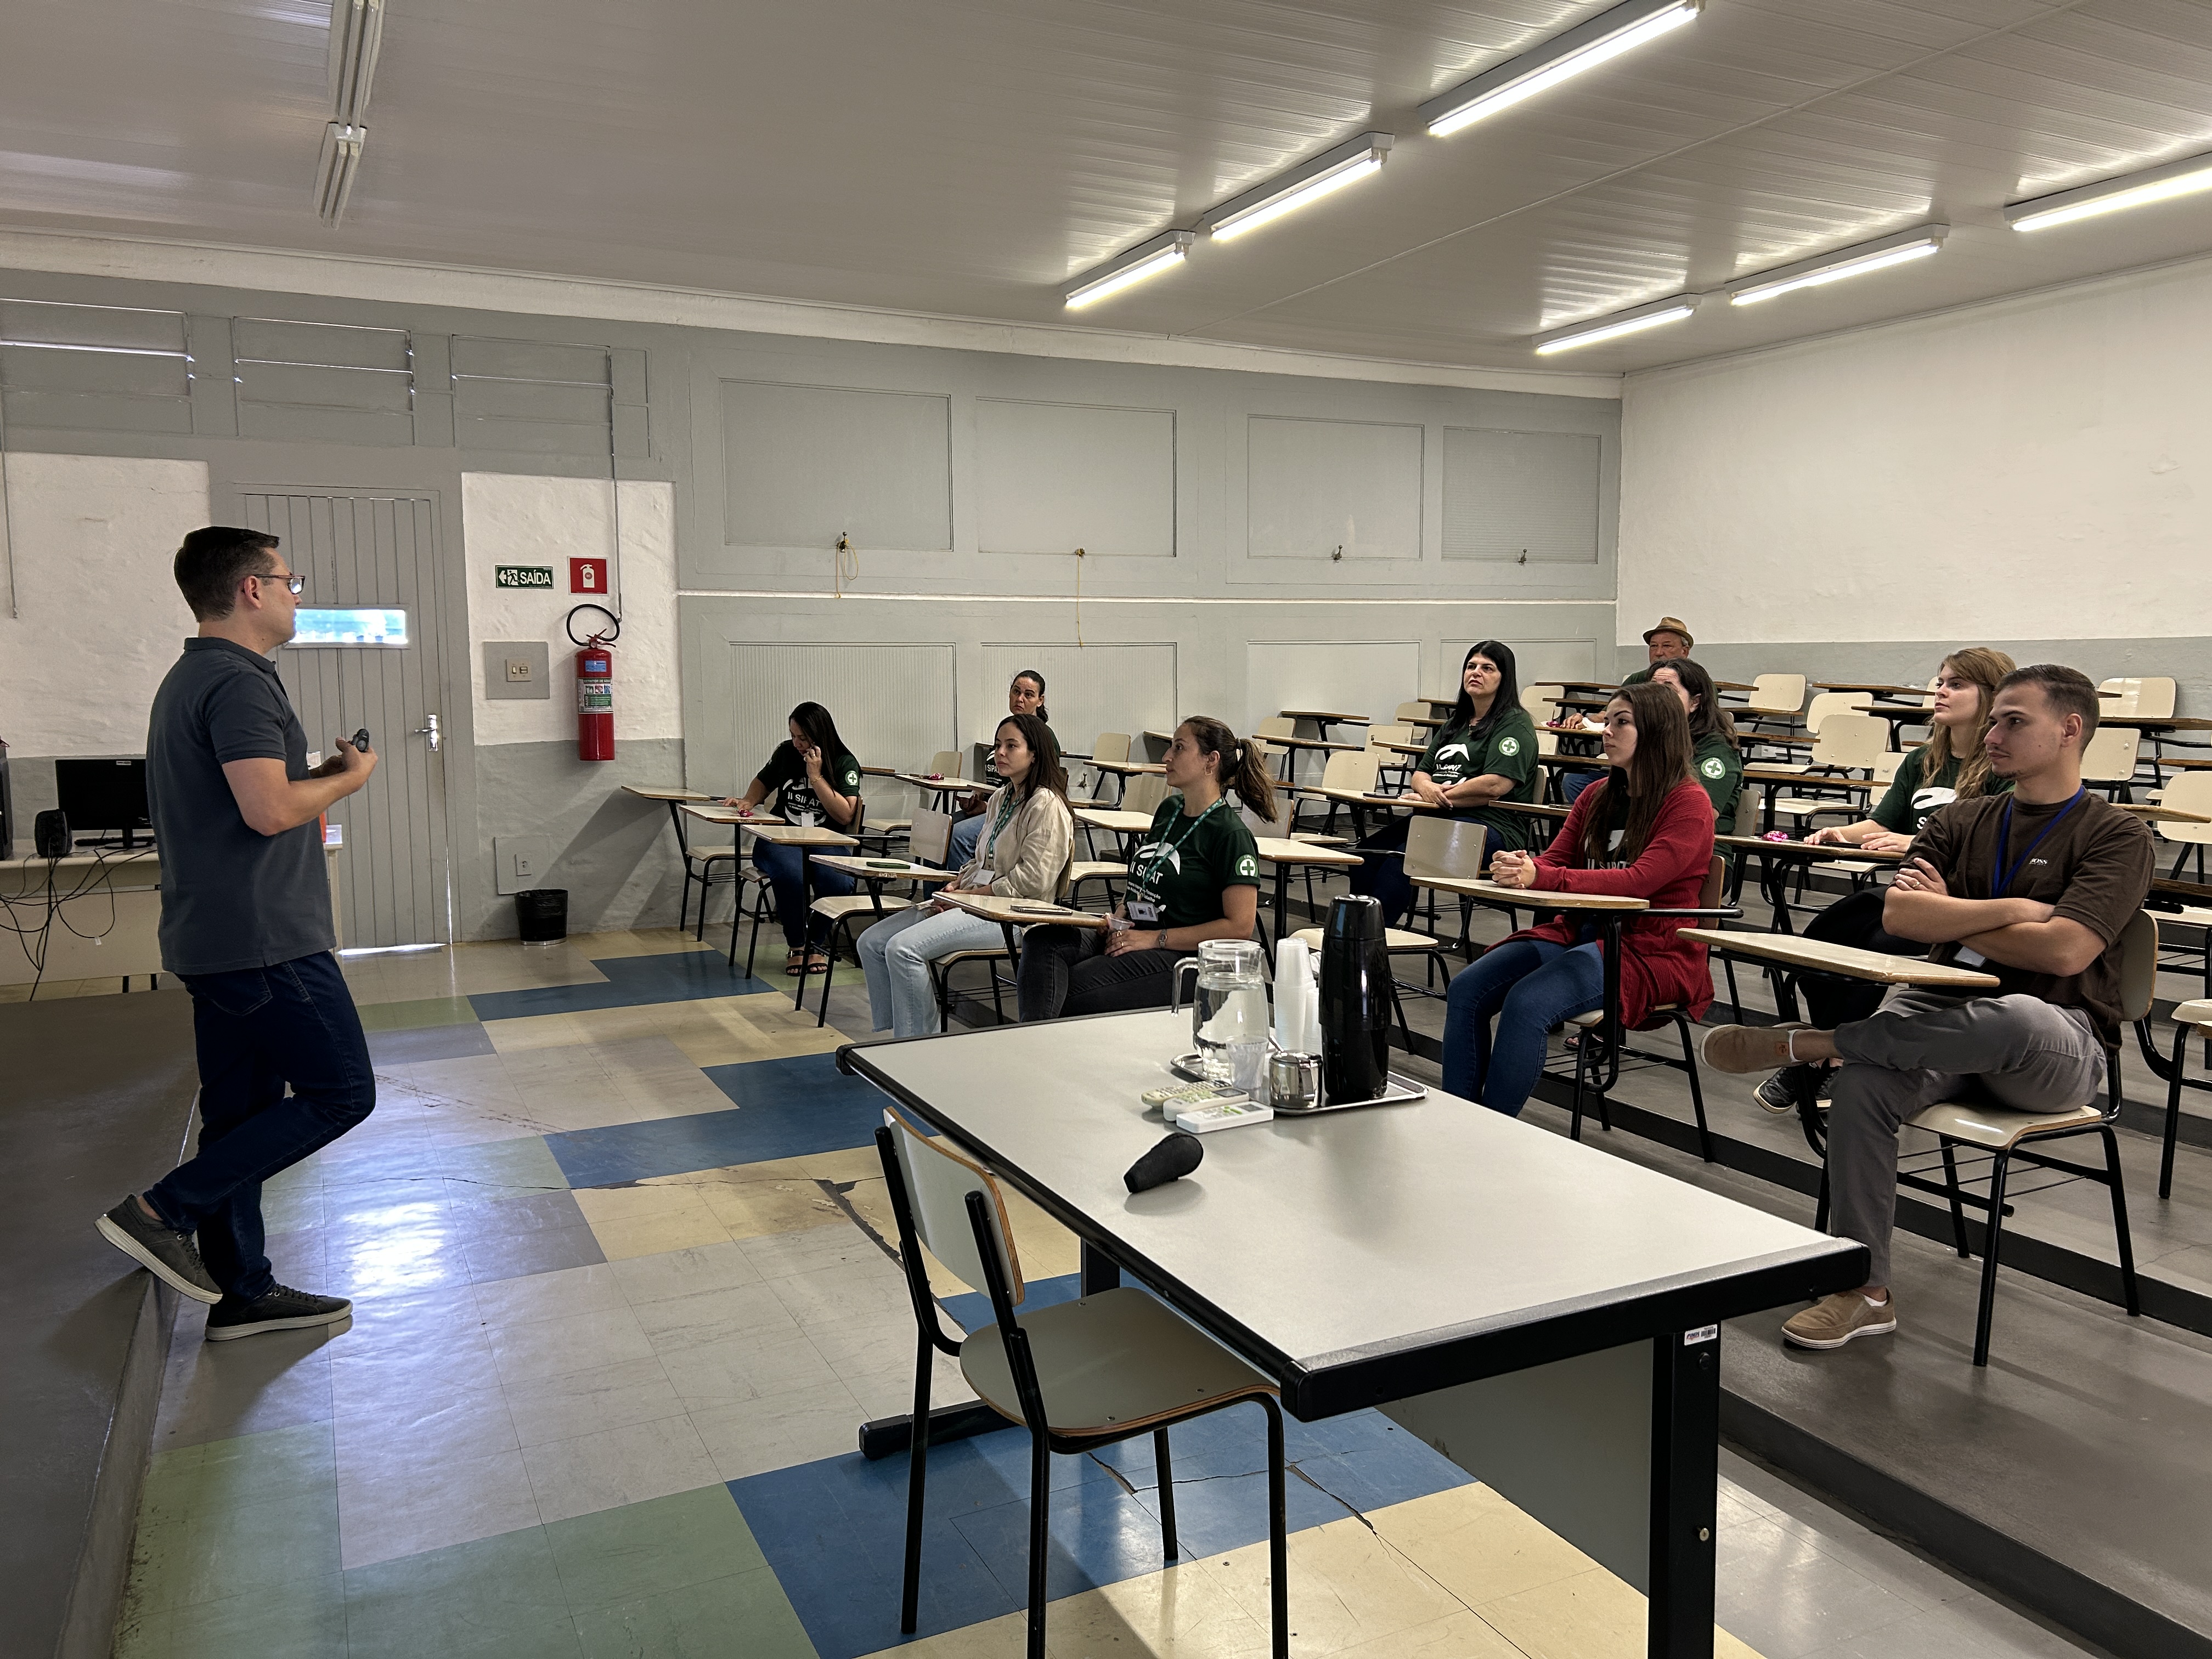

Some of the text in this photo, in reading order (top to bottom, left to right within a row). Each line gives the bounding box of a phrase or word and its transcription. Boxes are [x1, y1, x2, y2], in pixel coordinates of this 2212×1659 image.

[520, 569, 551, 585] SAÍDA
[787, 791, 793, 800] II
[1130, 860, 1136, 873] II
[1137, 864, 1163, 884] SIAT
